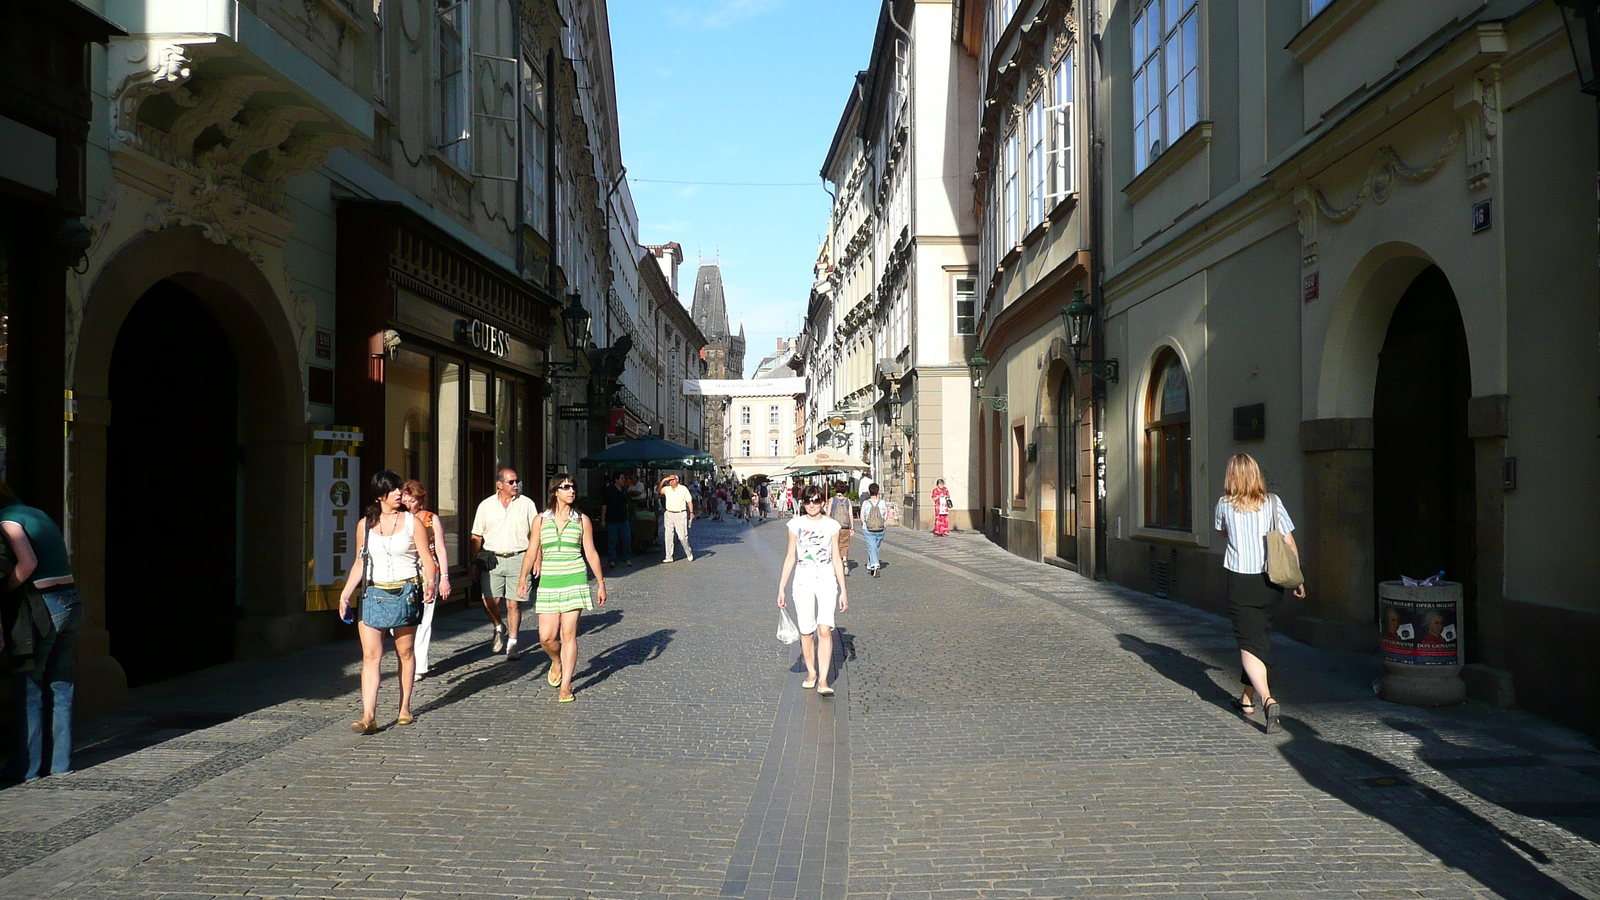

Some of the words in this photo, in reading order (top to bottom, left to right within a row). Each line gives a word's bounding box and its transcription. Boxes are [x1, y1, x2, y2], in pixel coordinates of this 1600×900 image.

[1475, 208, 1485, 225] 16
[471, 318, 510, 358] GUESS
[330, 457, 351, 577] HOTEL
